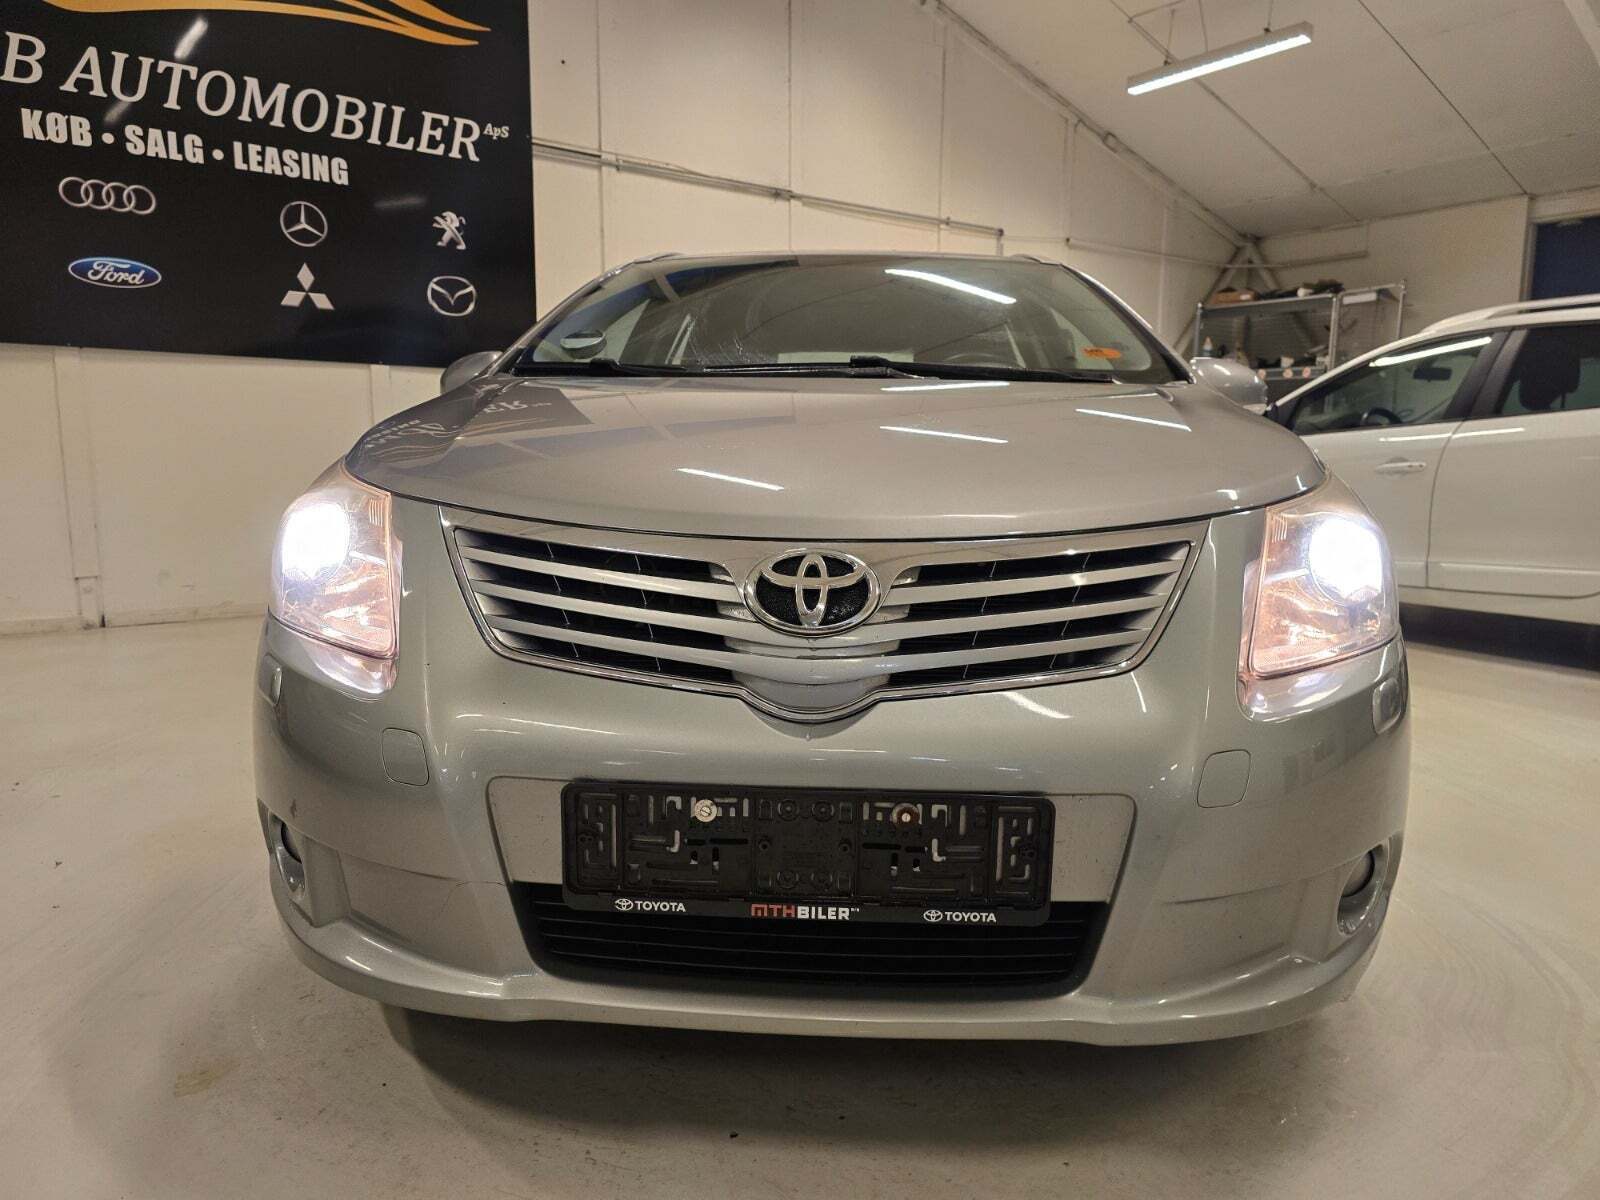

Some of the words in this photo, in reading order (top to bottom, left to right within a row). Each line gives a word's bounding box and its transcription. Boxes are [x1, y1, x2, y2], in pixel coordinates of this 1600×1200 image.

[0, 31, 46, 84] B
[59, 46, 480, 162] AUTOMOBILER
[483, 123, 510, 140] ApS
[20, 107, 93, 146] KØB
[125, 125, 205, 163] SALG
[233, 141, 350, 186] LEASING
[87, 260, 145, 284] Ford
[634, 900, 686, 912] TOYOTA
[945, 911, 997, 923] TOYOTA
